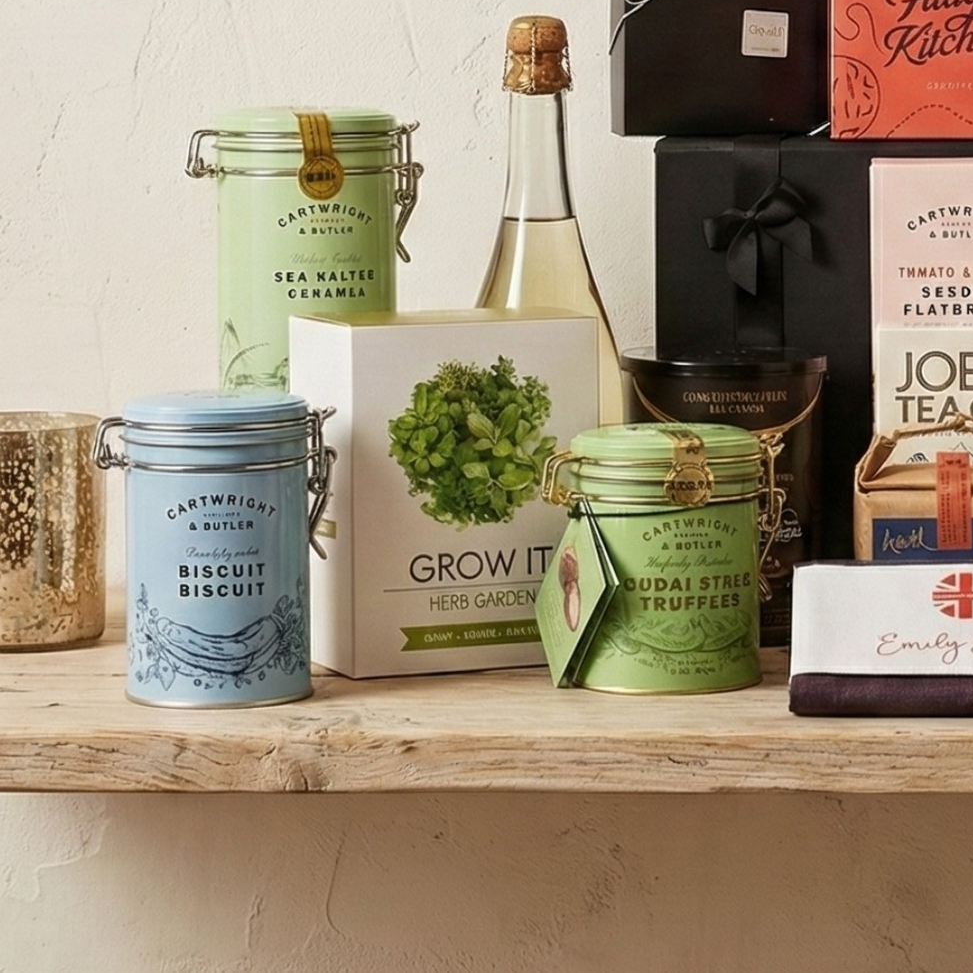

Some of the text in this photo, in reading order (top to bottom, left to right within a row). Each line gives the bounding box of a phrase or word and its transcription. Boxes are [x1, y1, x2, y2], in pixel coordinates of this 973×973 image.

[274, 271, 308, 283] SEA
[962, 266, 971, 279] &
[166, 493, 277, 521] CARTWRIGHT
[178, 562, 266, 579] BISCUIT
[409, 546, 554, 584] GROW IT
[179, 582, 265, 598] BISCUIT
[429, 589, 537, 613] HERB GARDEN
[876, 632, 968, 665] Emily
